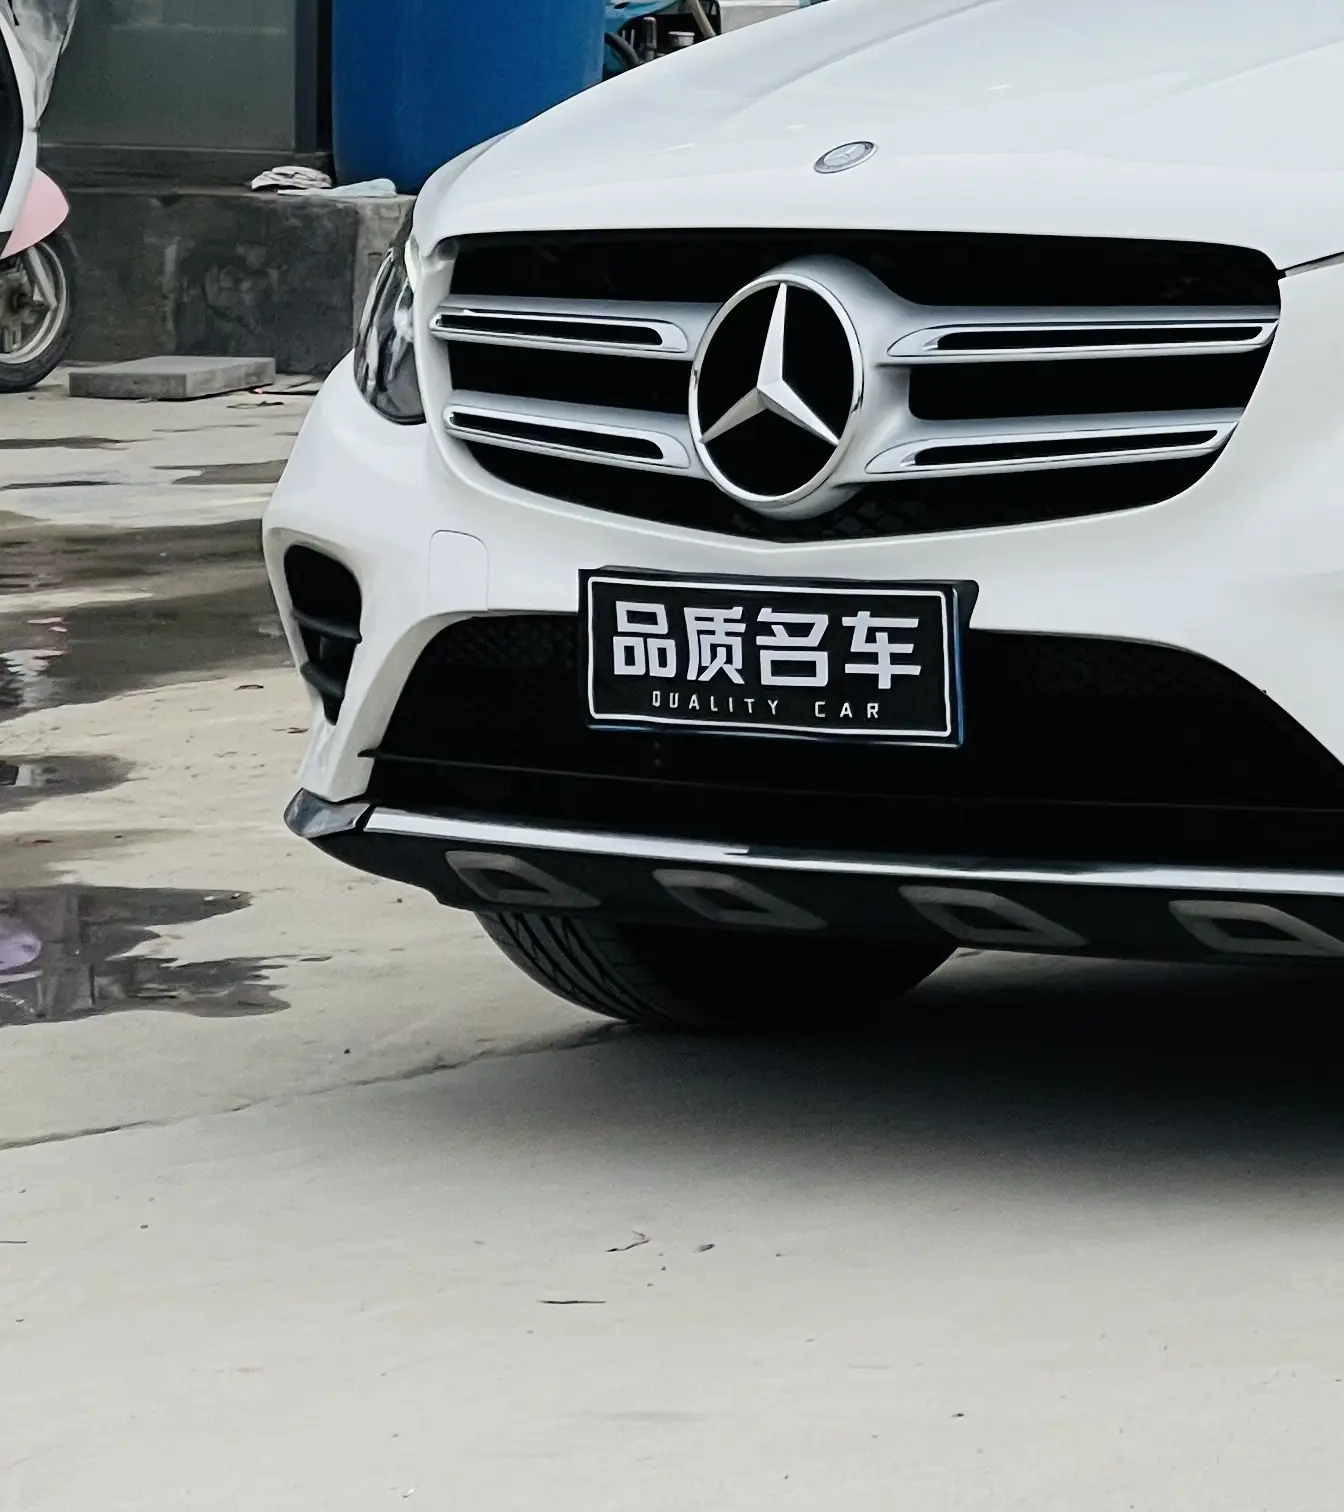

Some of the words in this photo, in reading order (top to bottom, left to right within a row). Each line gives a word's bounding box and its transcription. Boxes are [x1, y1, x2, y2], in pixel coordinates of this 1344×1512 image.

[612, 600, 922, 689] 品质名车
[652, 690, 779, 716] QUALITY
[814, 701, 880, 719] CAR
